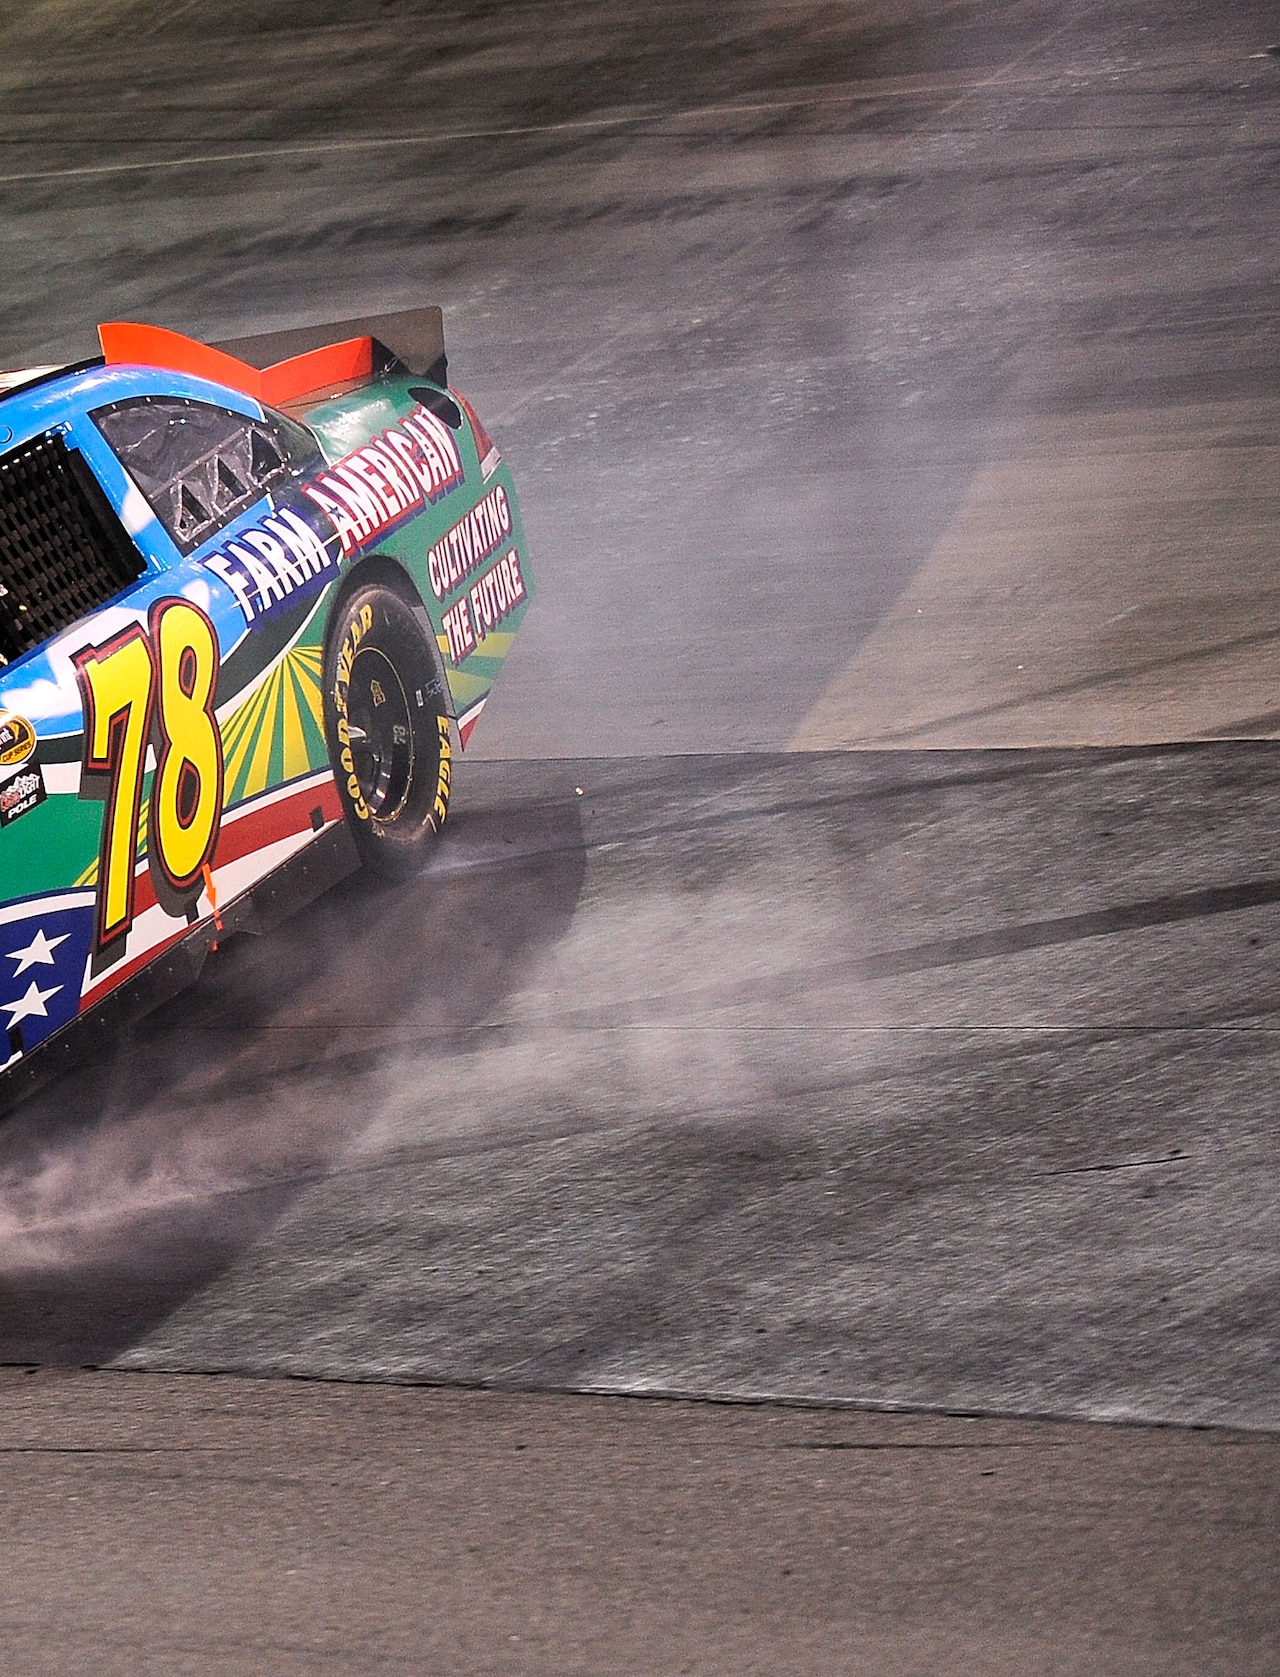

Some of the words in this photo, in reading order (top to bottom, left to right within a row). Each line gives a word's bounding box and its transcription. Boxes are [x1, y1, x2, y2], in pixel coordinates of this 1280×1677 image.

[205, 507, 331, 622] FARM
[306, 405, 461, 551] AMERICAN
[428, 484, 510, 598] CULTIVATING
[441, 598, 474, 662] THE
[470, 549, 523, 636] FUTURE
[78, 599, 220, 938] 78
[335, 604, 373, 820] GOODYEAR
[7, 794, 38, 819] POLE
[434, 715, 452, 825] EAGLE
